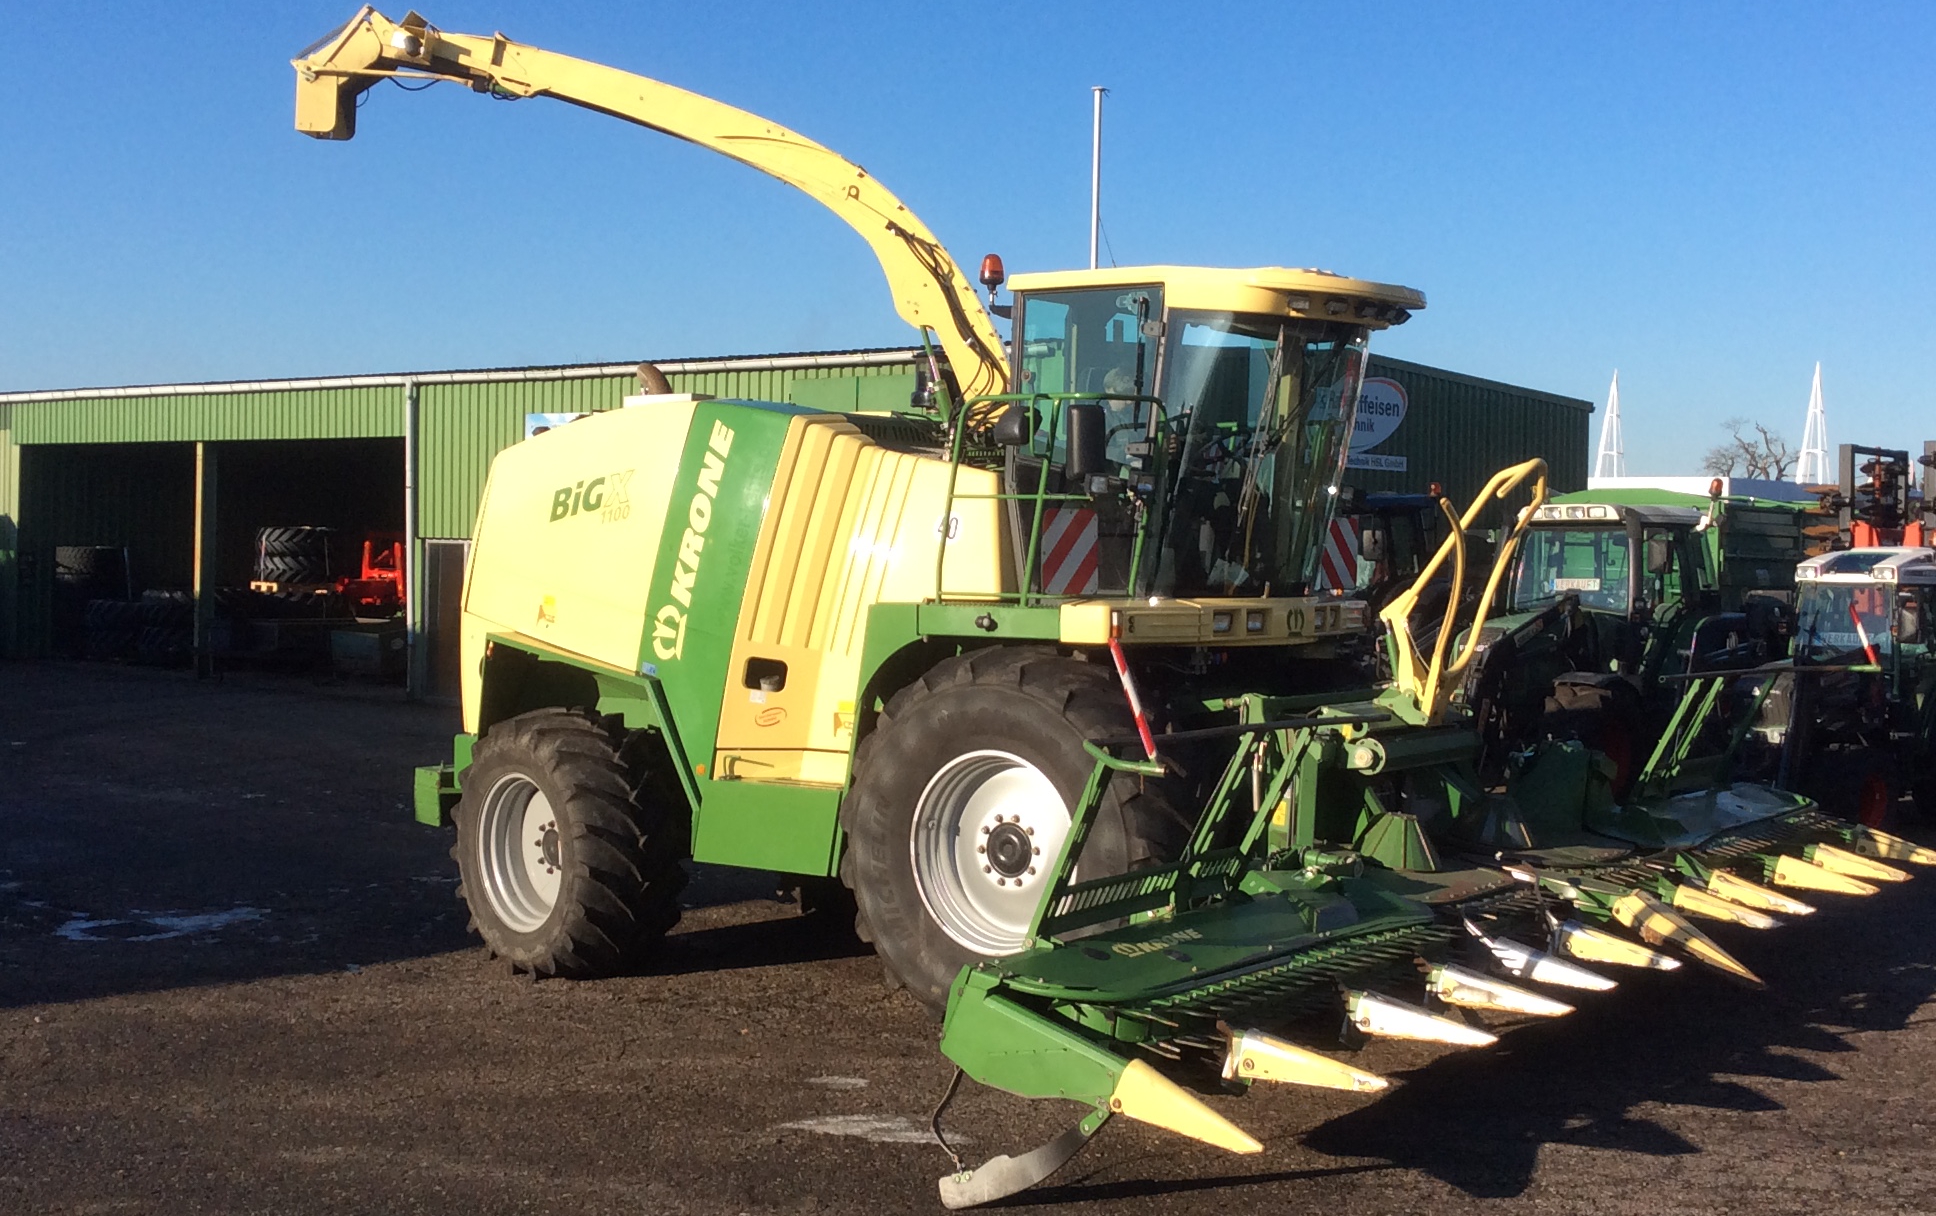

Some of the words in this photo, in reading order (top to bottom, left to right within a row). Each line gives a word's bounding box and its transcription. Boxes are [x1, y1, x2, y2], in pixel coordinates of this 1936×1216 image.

[601, 504, 630, 525] 1100
[671, 419, 735, 608] KRONE
[1136, 928, 1203, 953] KRONE
